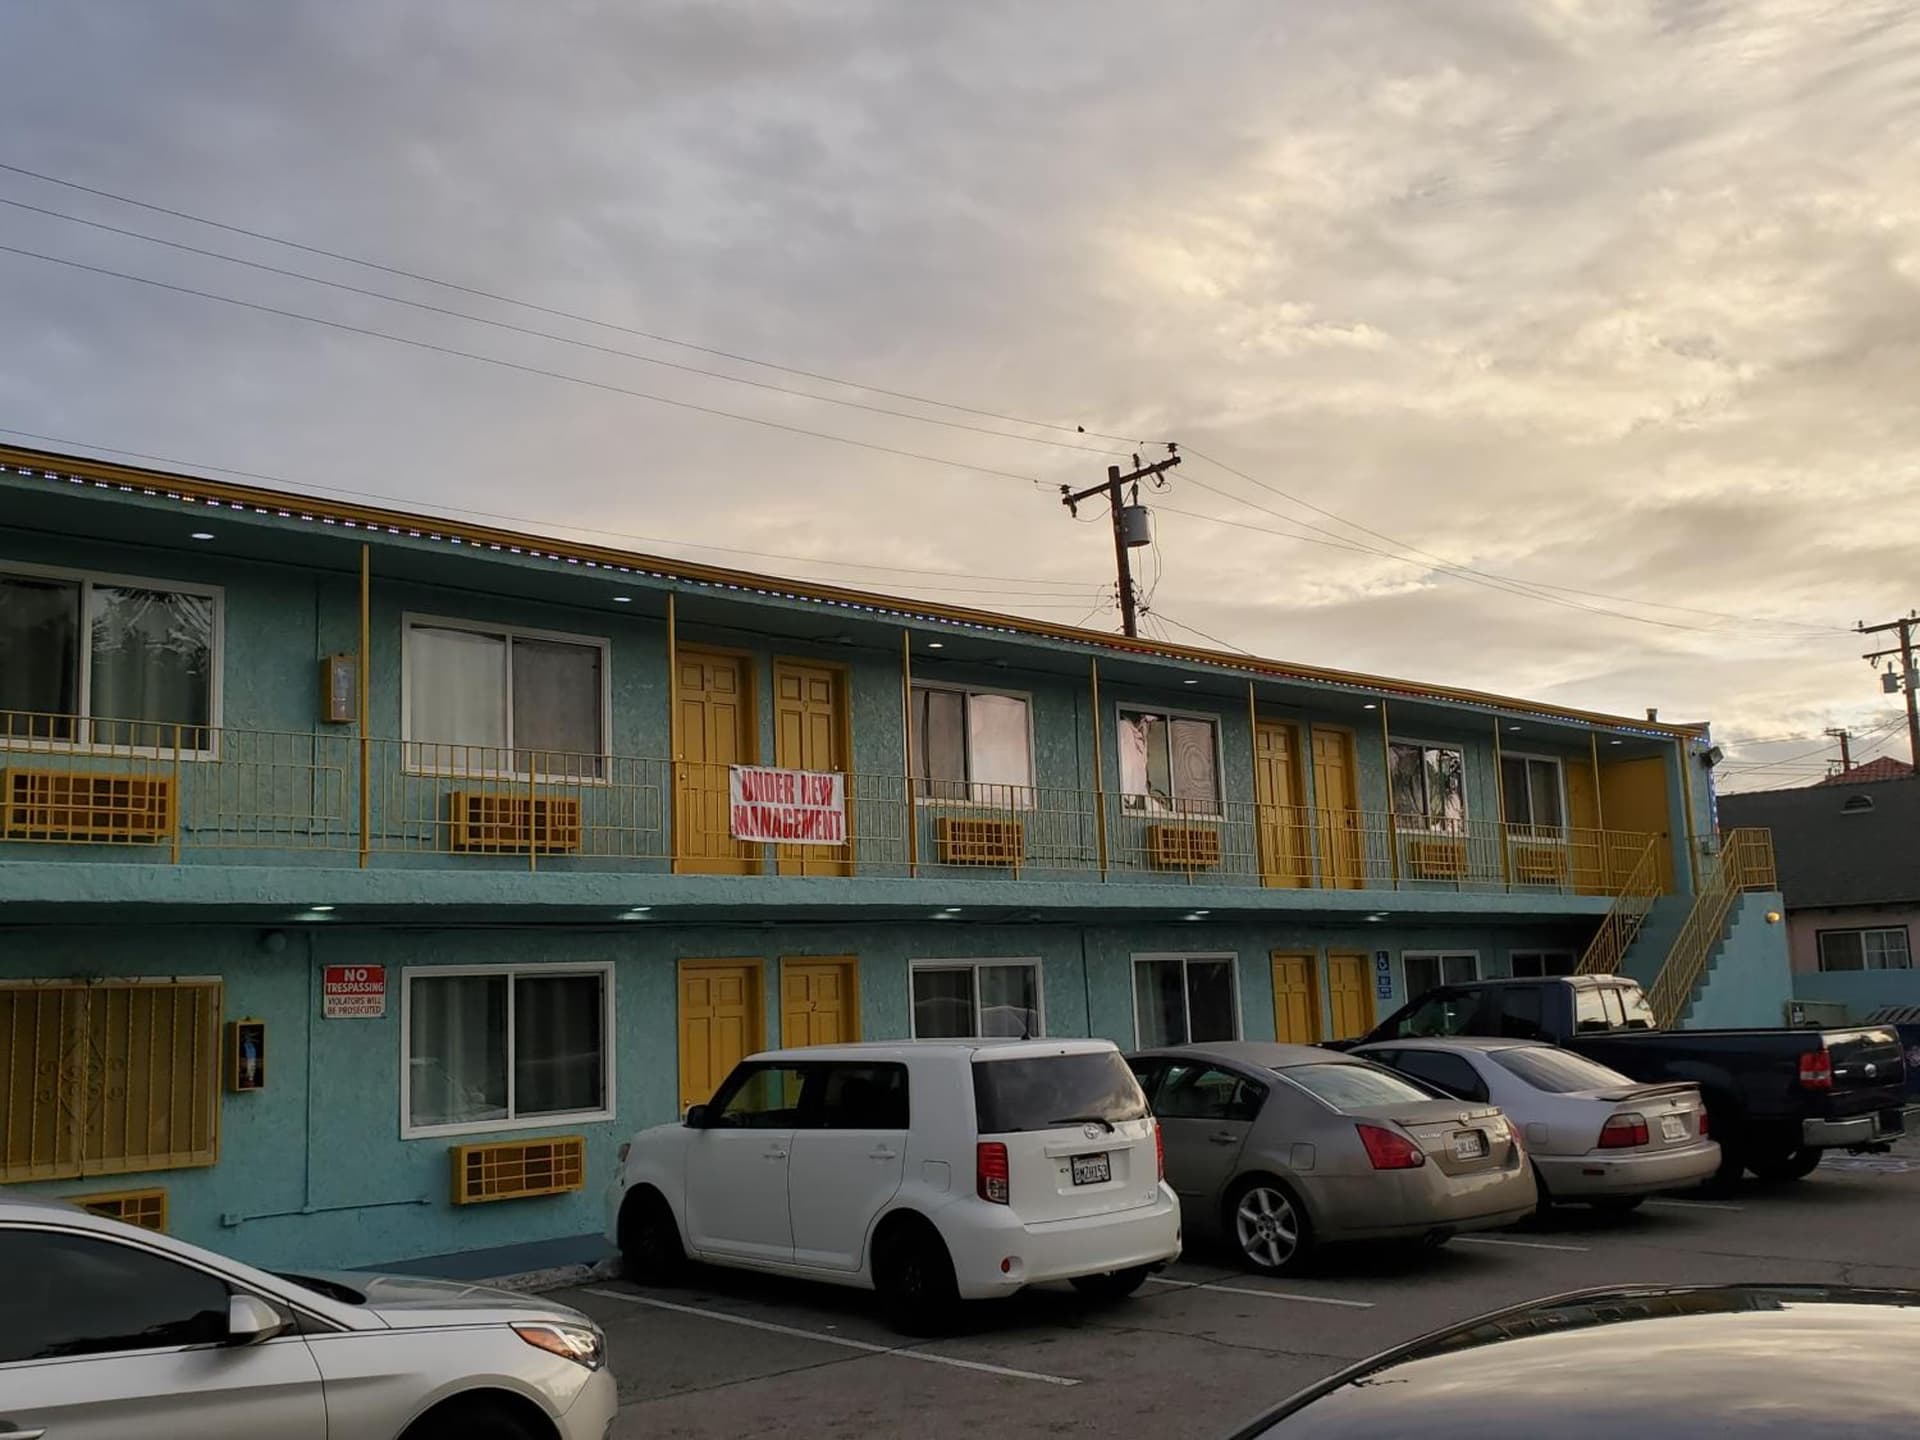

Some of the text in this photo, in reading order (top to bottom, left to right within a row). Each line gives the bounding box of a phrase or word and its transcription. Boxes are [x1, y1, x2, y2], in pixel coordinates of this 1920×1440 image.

[742, 769, 833, 807] UNDER NEW
[733, 804, 842, 841] MANAGEMENT
[343, 968, 368, 982] NO
[327, 982, 384, 993] TRESPASSING
[327, 996, 382, 1005] VIOLATORS WILL
[327, 1005, 382, 1015] BE PROSECUTED
